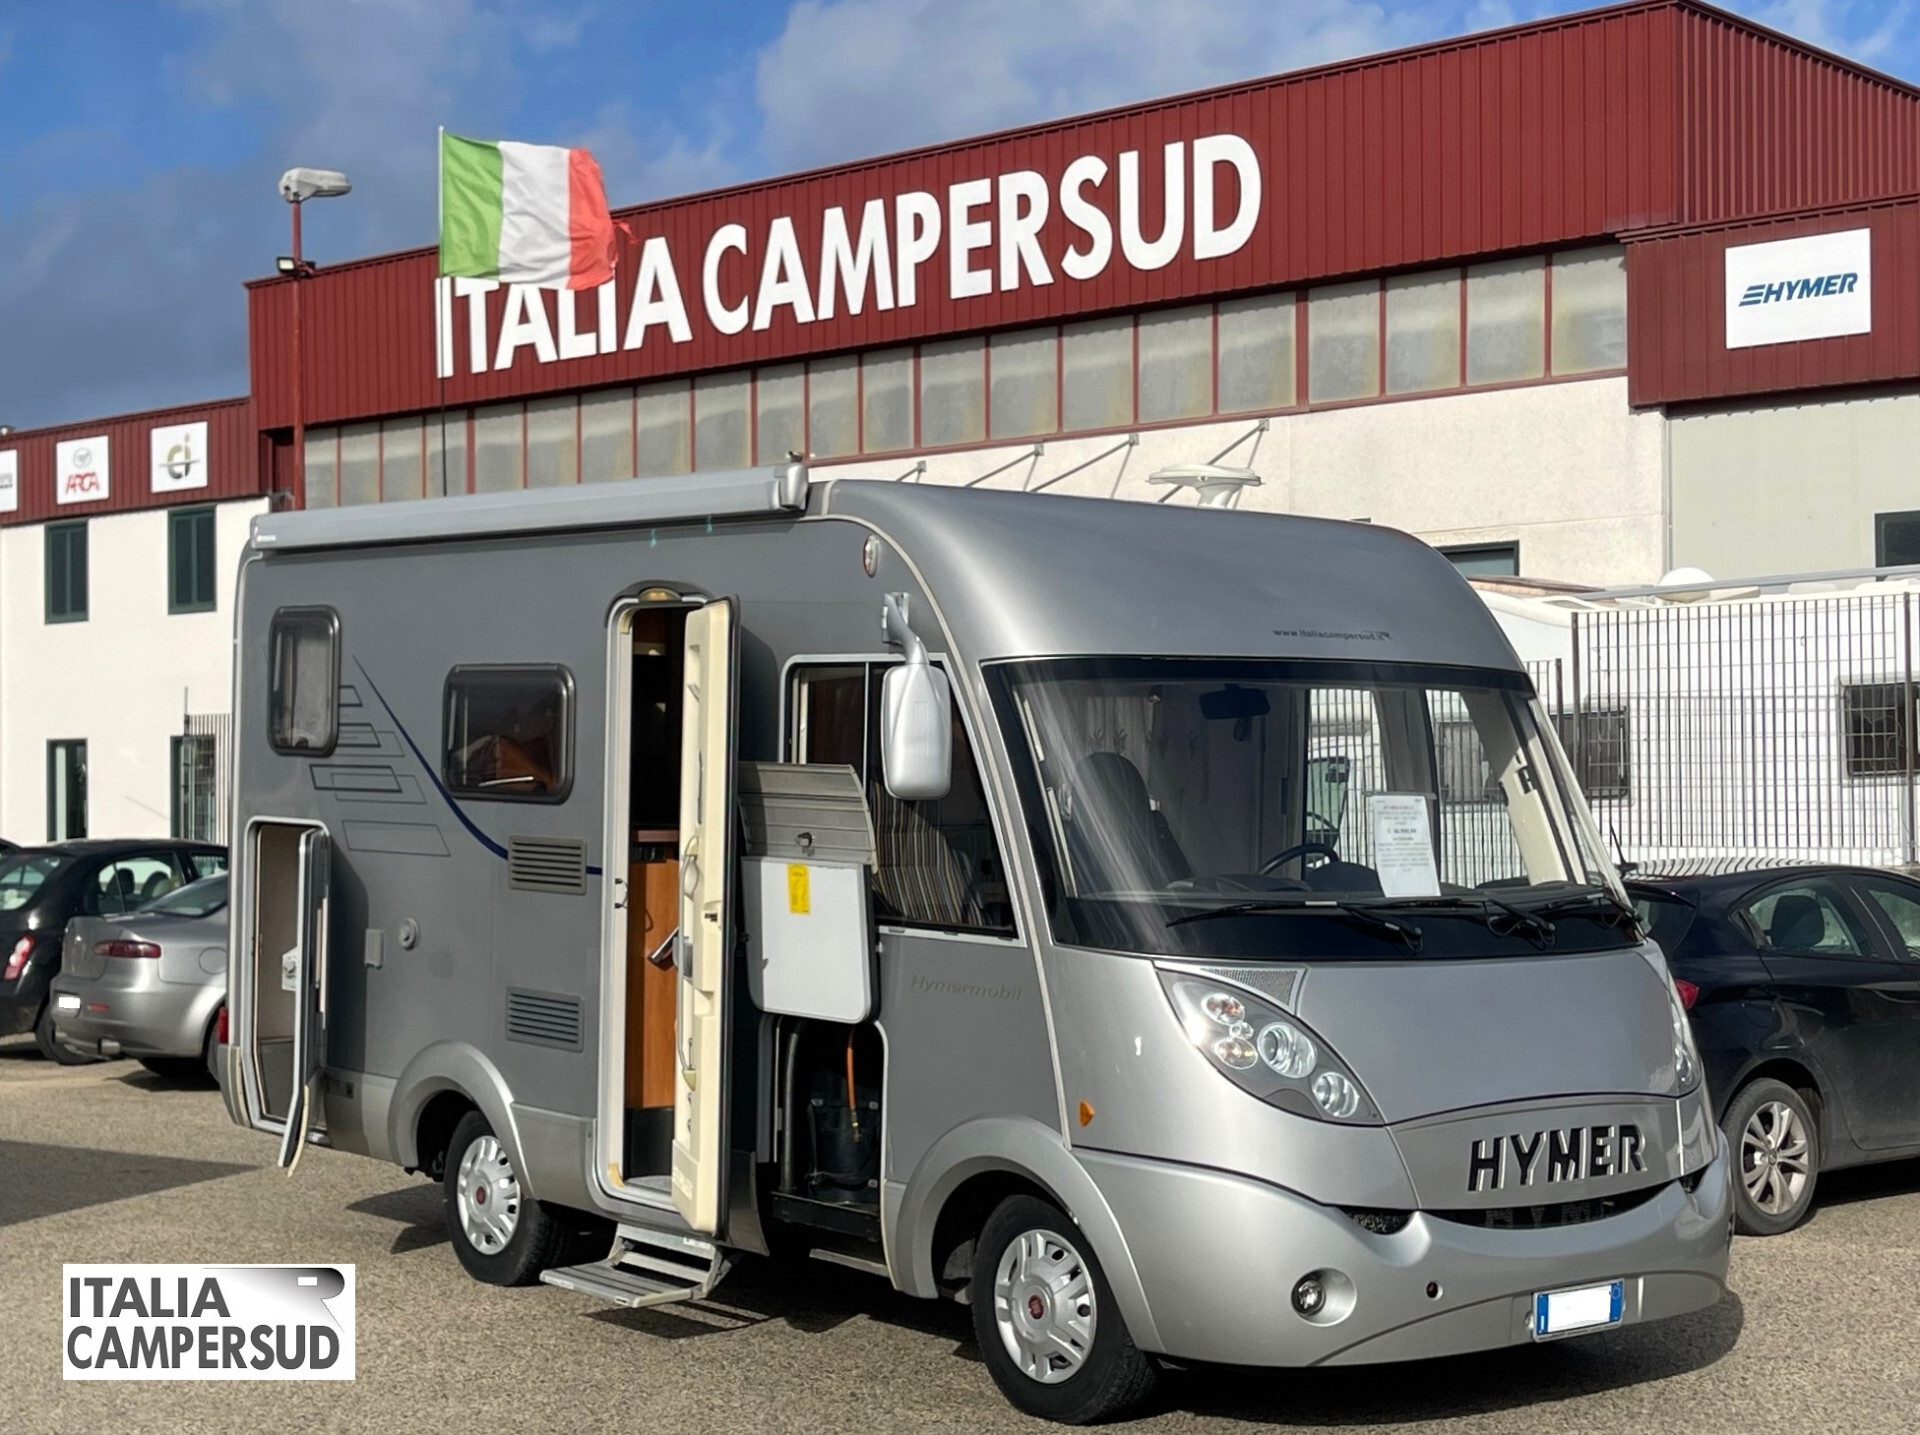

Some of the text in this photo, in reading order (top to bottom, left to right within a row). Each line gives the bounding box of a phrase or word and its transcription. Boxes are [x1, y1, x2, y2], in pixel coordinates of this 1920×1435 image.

[435, 133, 1262, 379] ITALIA CAMPERSUD
[1762, 272, 1858, 303] HYMER
[910, 973, 1023, 1000] Hymermobil
[1467, 1124, 1648, 1192] HYMER
